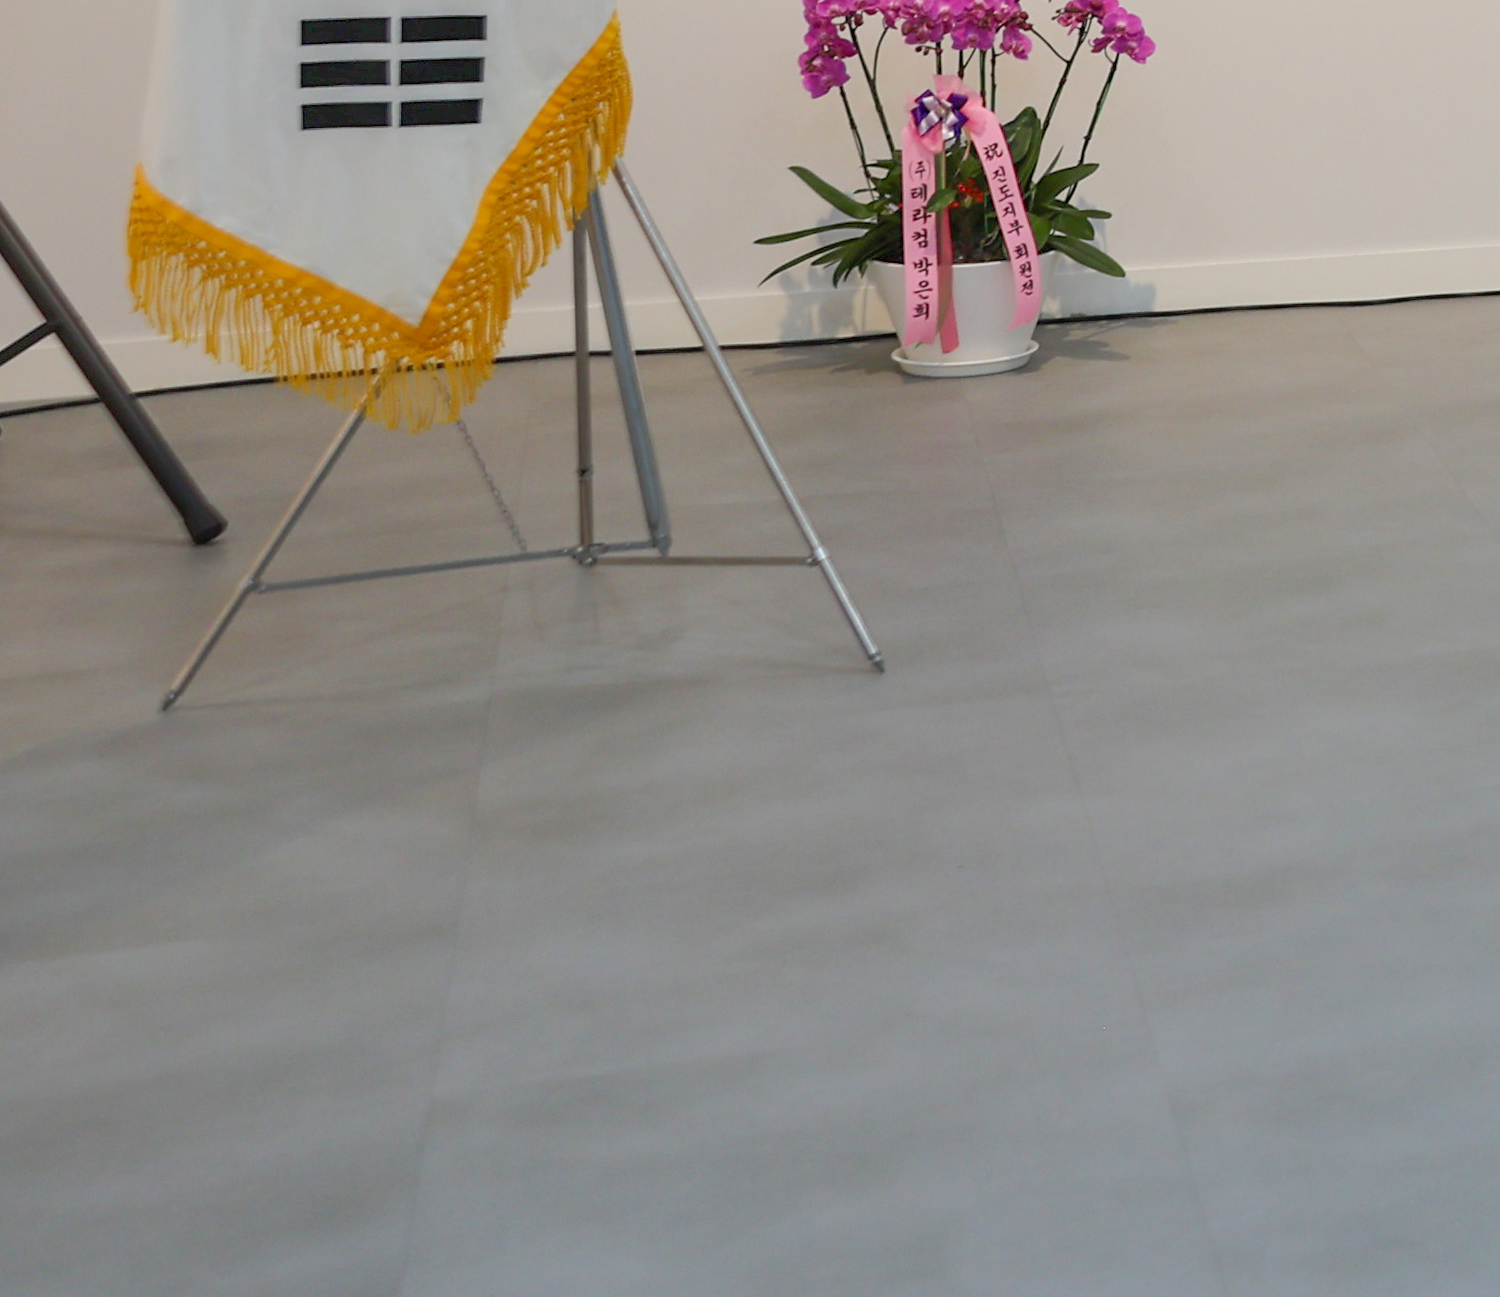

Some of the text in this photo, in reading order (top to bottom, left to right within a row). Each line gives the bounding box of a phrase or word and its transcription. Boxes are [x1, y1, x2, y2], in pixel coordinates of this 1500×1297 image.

[992, 165, 1024, 236] 진도지부
[1013, 242, 1035, 296] 회원전
[912, 256, 934, 324] 박은희
